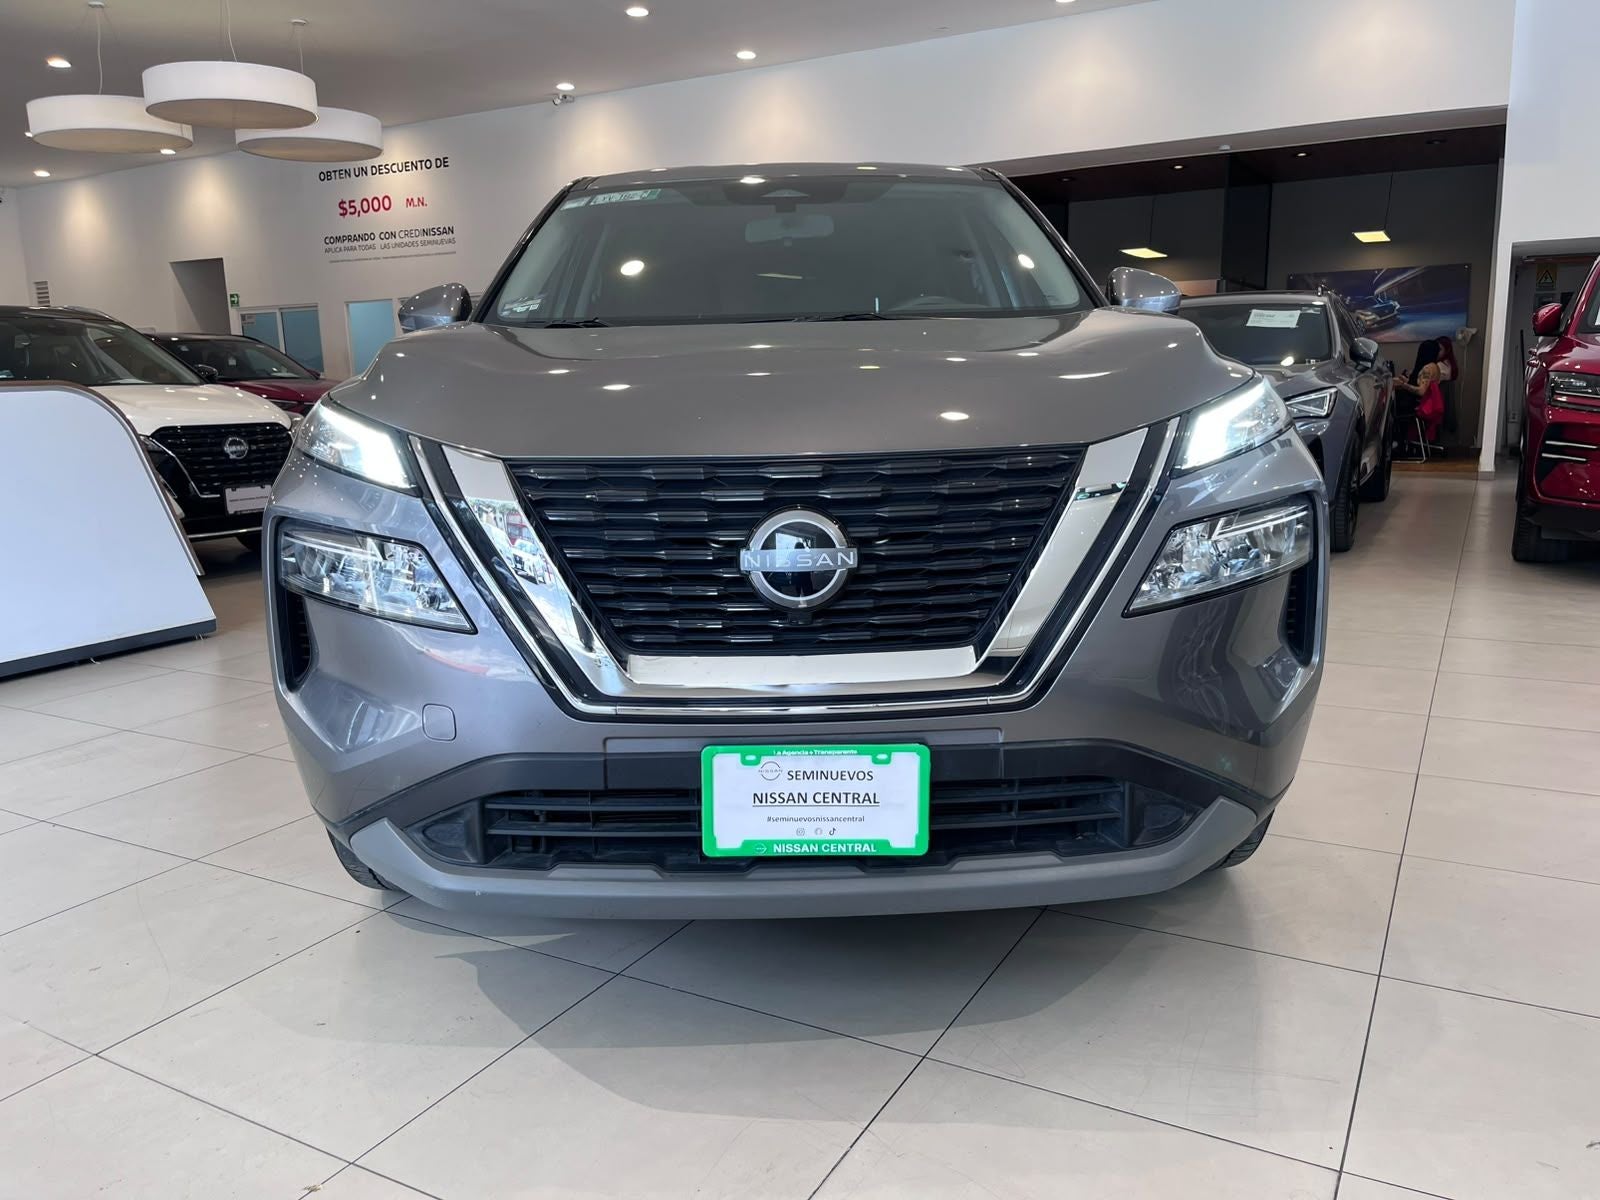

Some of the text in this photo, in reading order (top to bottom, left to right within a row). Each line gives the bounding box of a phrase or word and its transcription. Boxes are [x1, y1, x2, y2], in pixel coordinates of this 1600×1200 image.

[318, 156, 449, 182] OBTEN UN DESCUENTO DE
[338, 194, 428, 218] $5,000 M.N.
[323, 232, 376, 245] COMPRANDO
[378, 230, 397, 241] CON
[324, 245, 342, 254] APLICA
[359, 243, 377, 252] TODAS
[391, 240, 420, 249] UNIDADES
[787, 769, 874, 781] SEMINUEVOS
[753, 791, 880, 804] NISSAN CENTRAL
[767, 815, 865, 823] #seminuevosnissancentral
[773, 842, 877, 853] NISSAN CENTRAL
